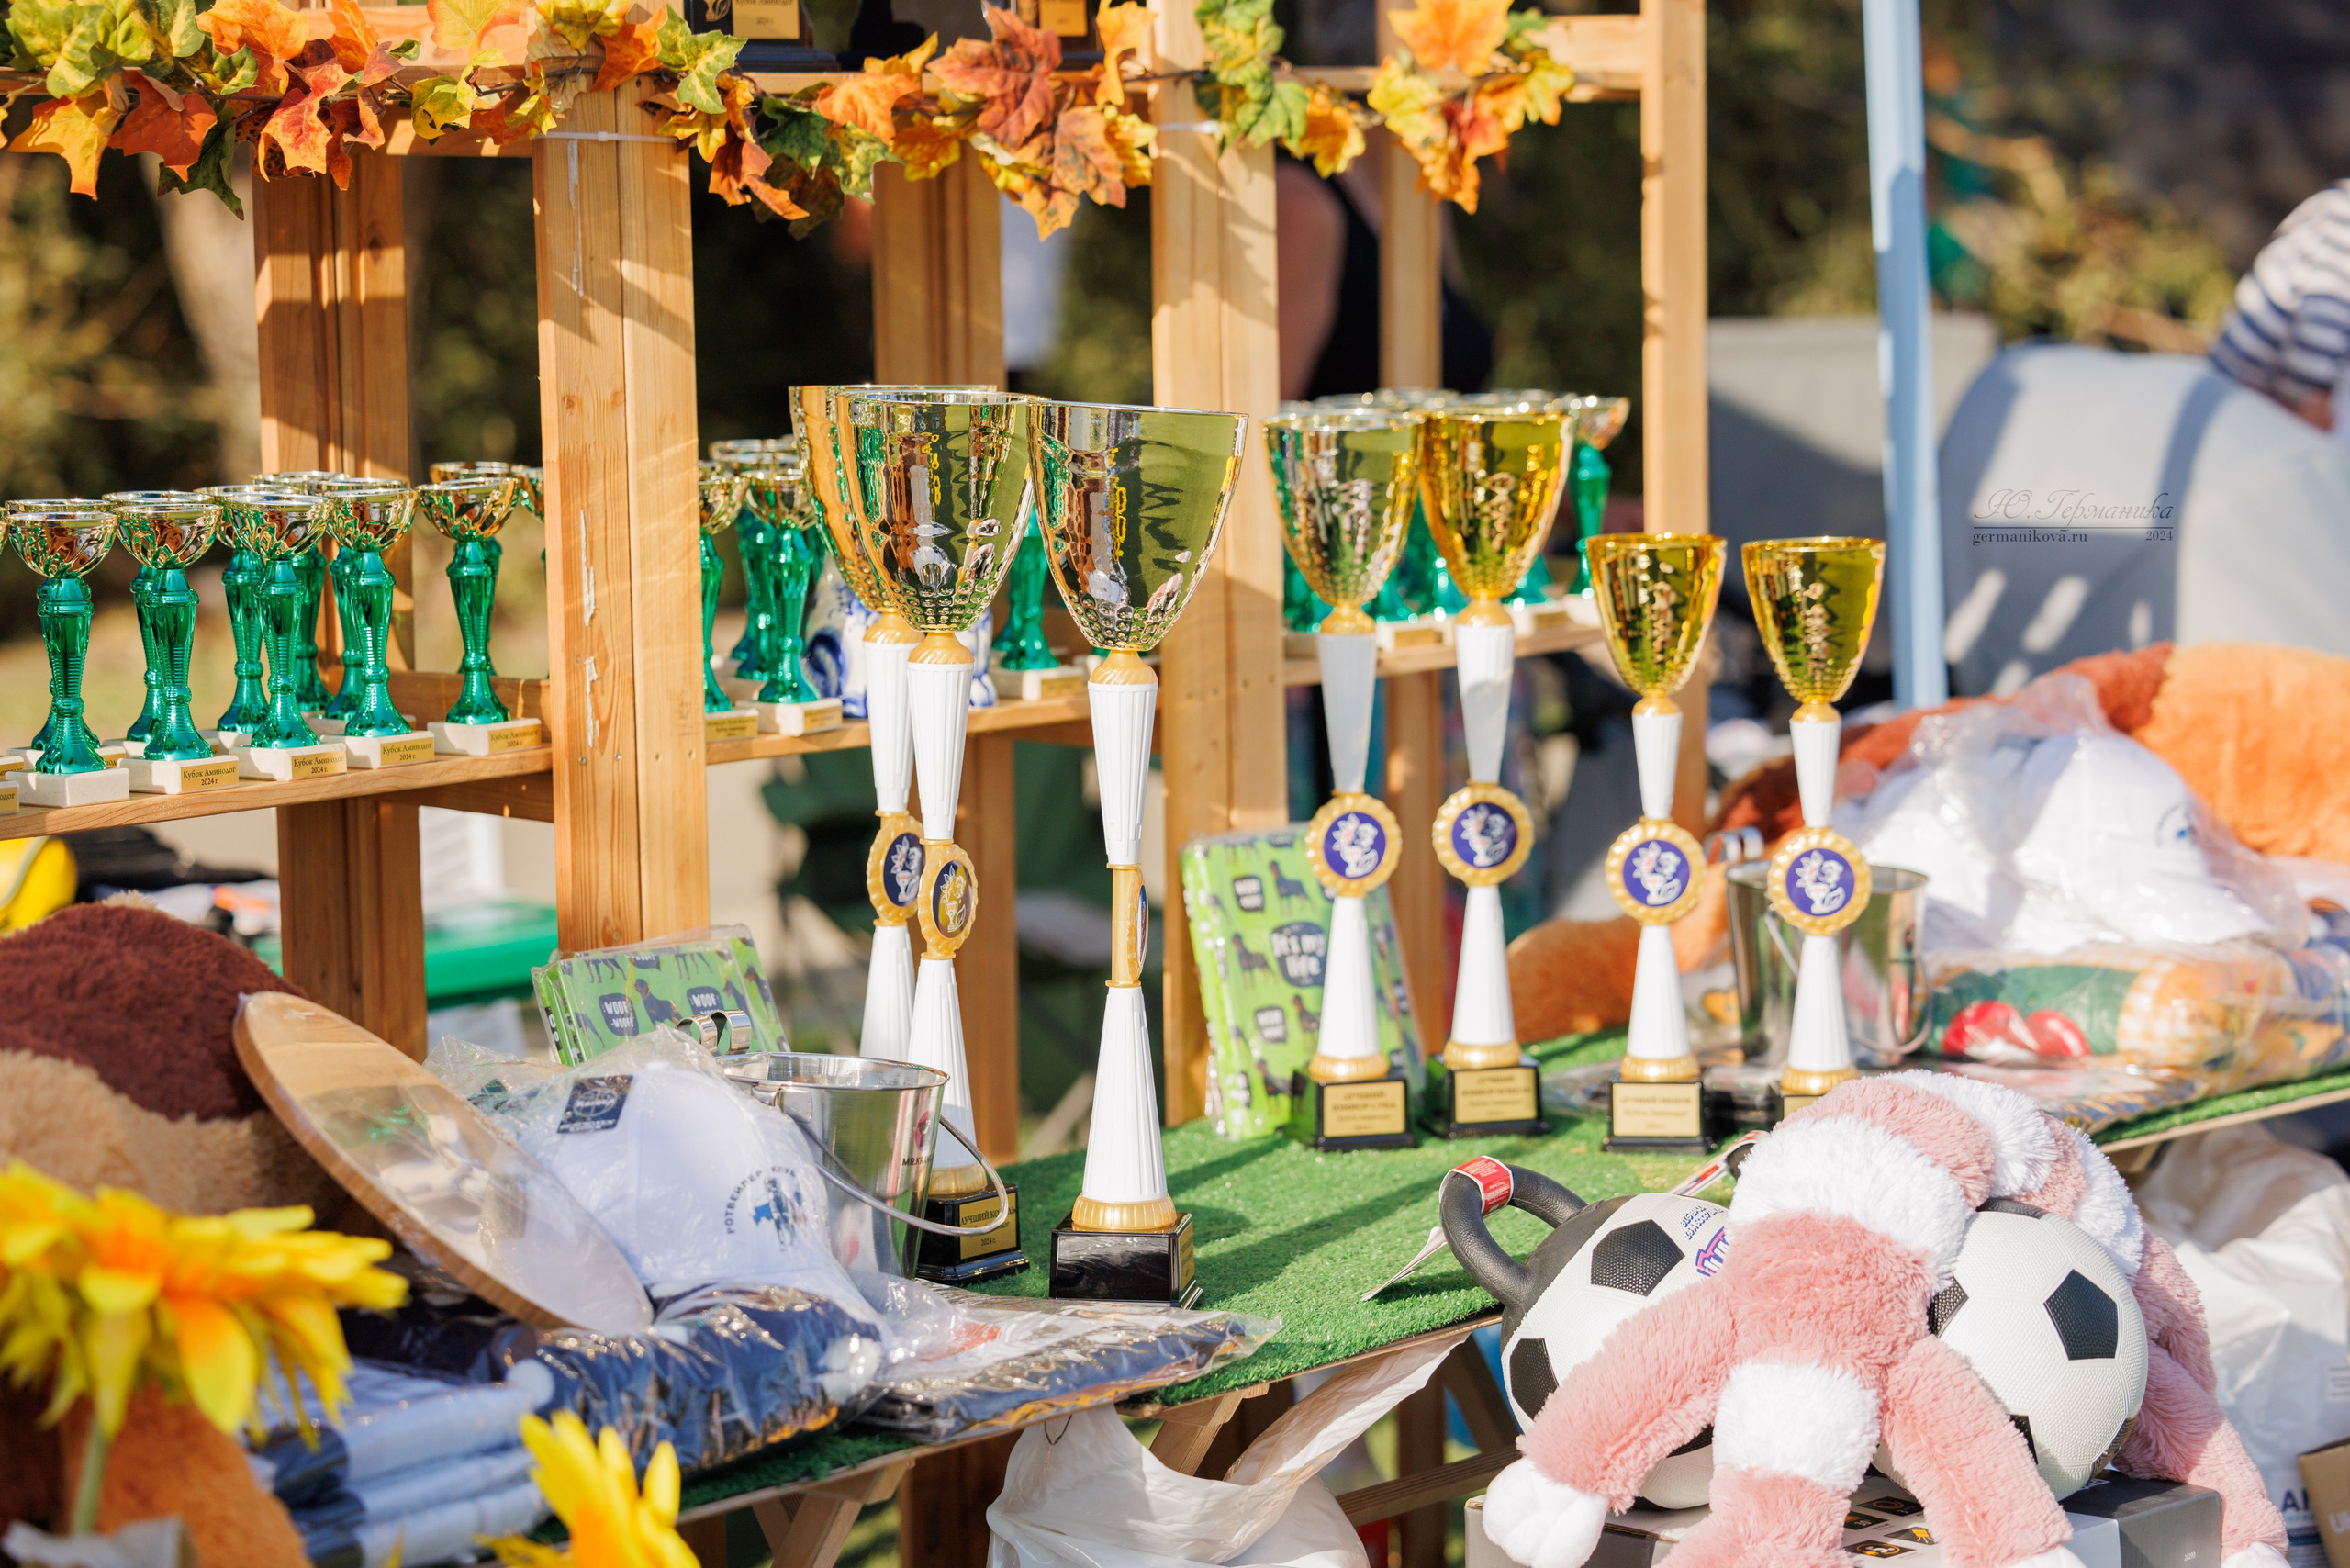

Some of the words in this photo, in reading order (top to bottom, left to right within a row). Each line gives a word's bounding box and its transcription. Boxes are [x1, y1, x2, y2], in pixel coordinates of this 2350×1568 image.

[383, 746, 401, 756] Кубок
[402, 743, 432, 752] Аминодог
[294, 758, 313, 768] Кубок
[314, 756, 344, 765] Аминодог
[183, 771, 204, 779] Кубок
[204, 767, 236, 776] Аминодог
[692, 992, 717, 1008] WOOF
[960, 1211, 990, 1226] ЛУЧШИЙ
[990, 1205, 1016, 1219] КОЛЬ
